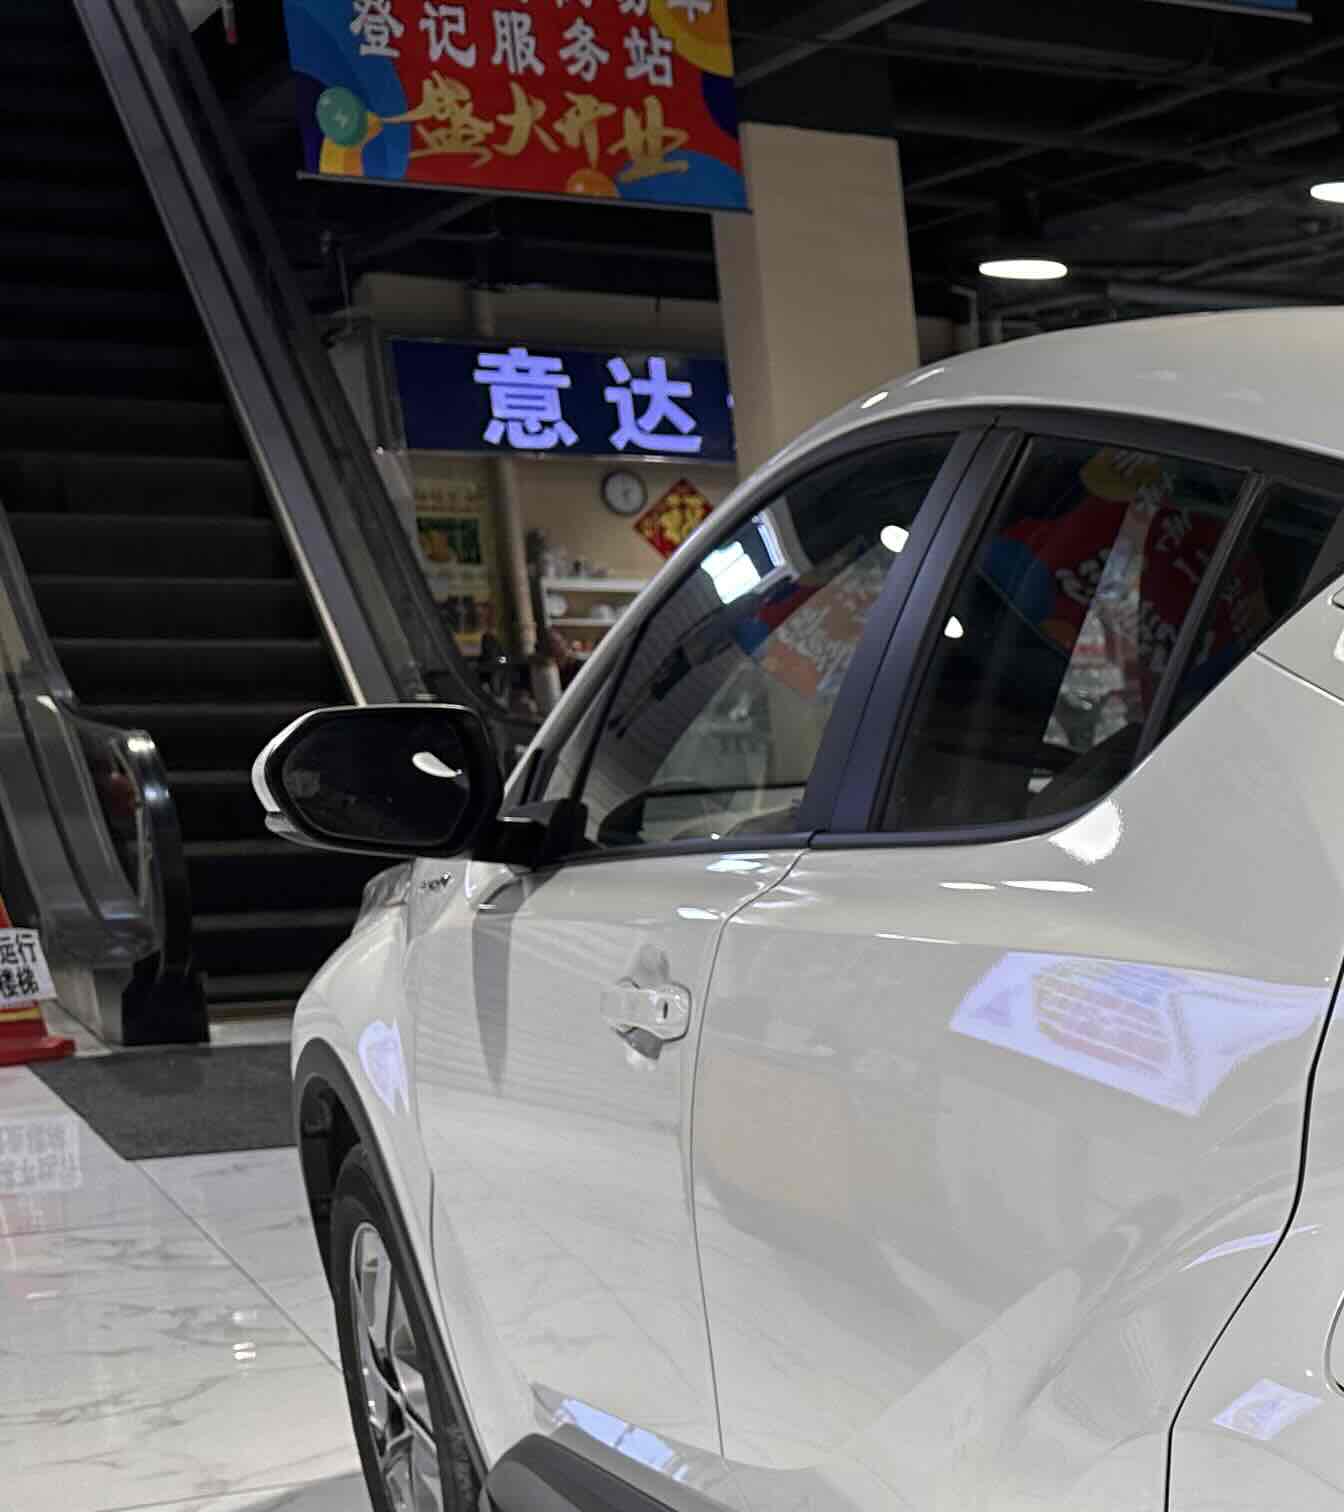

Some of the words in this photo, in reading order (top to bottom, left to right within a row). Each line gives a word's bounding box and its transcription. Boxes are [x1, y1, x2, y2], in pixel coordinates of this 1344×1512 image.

[350, 0, 673, 87] 登记服务站
[381, 69, 689, 182] 盛大开业
[473, 347, 734, 453] 意达
